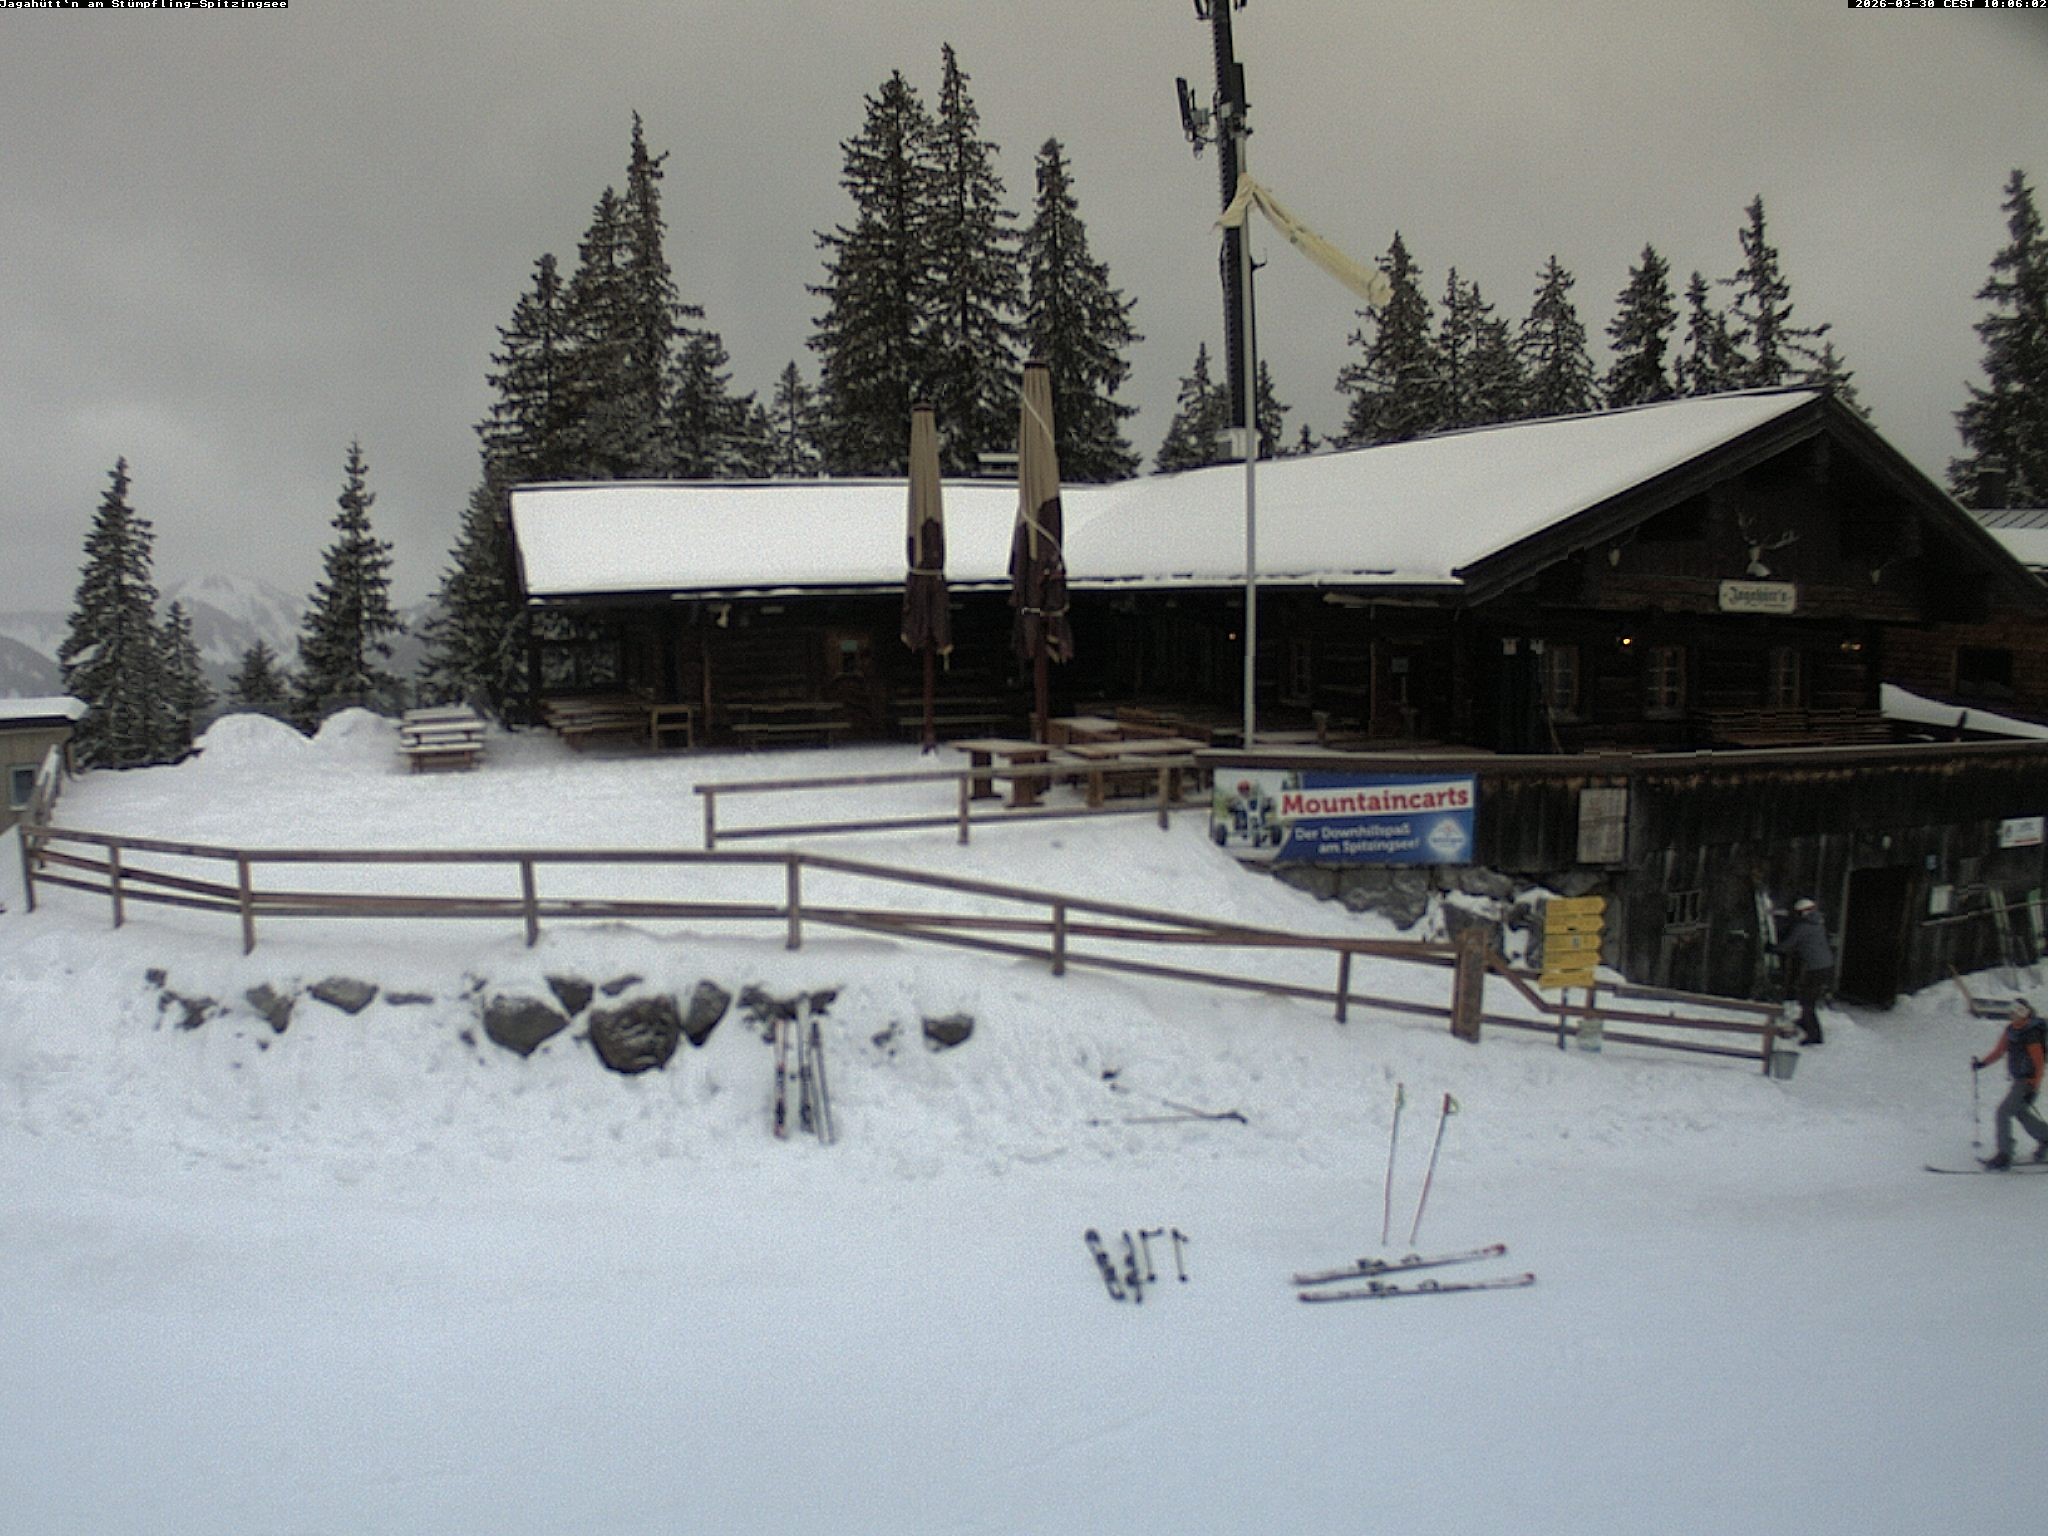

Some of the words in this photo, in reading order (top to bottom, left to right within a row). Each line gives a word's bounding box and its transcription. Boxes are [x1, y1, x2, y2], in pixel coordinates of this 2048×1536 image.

[1282, 789, 1468, 814] Mountaincarts
[1294, 827, 1319, 841] Der
[1318, 843, 1341, 854] am
